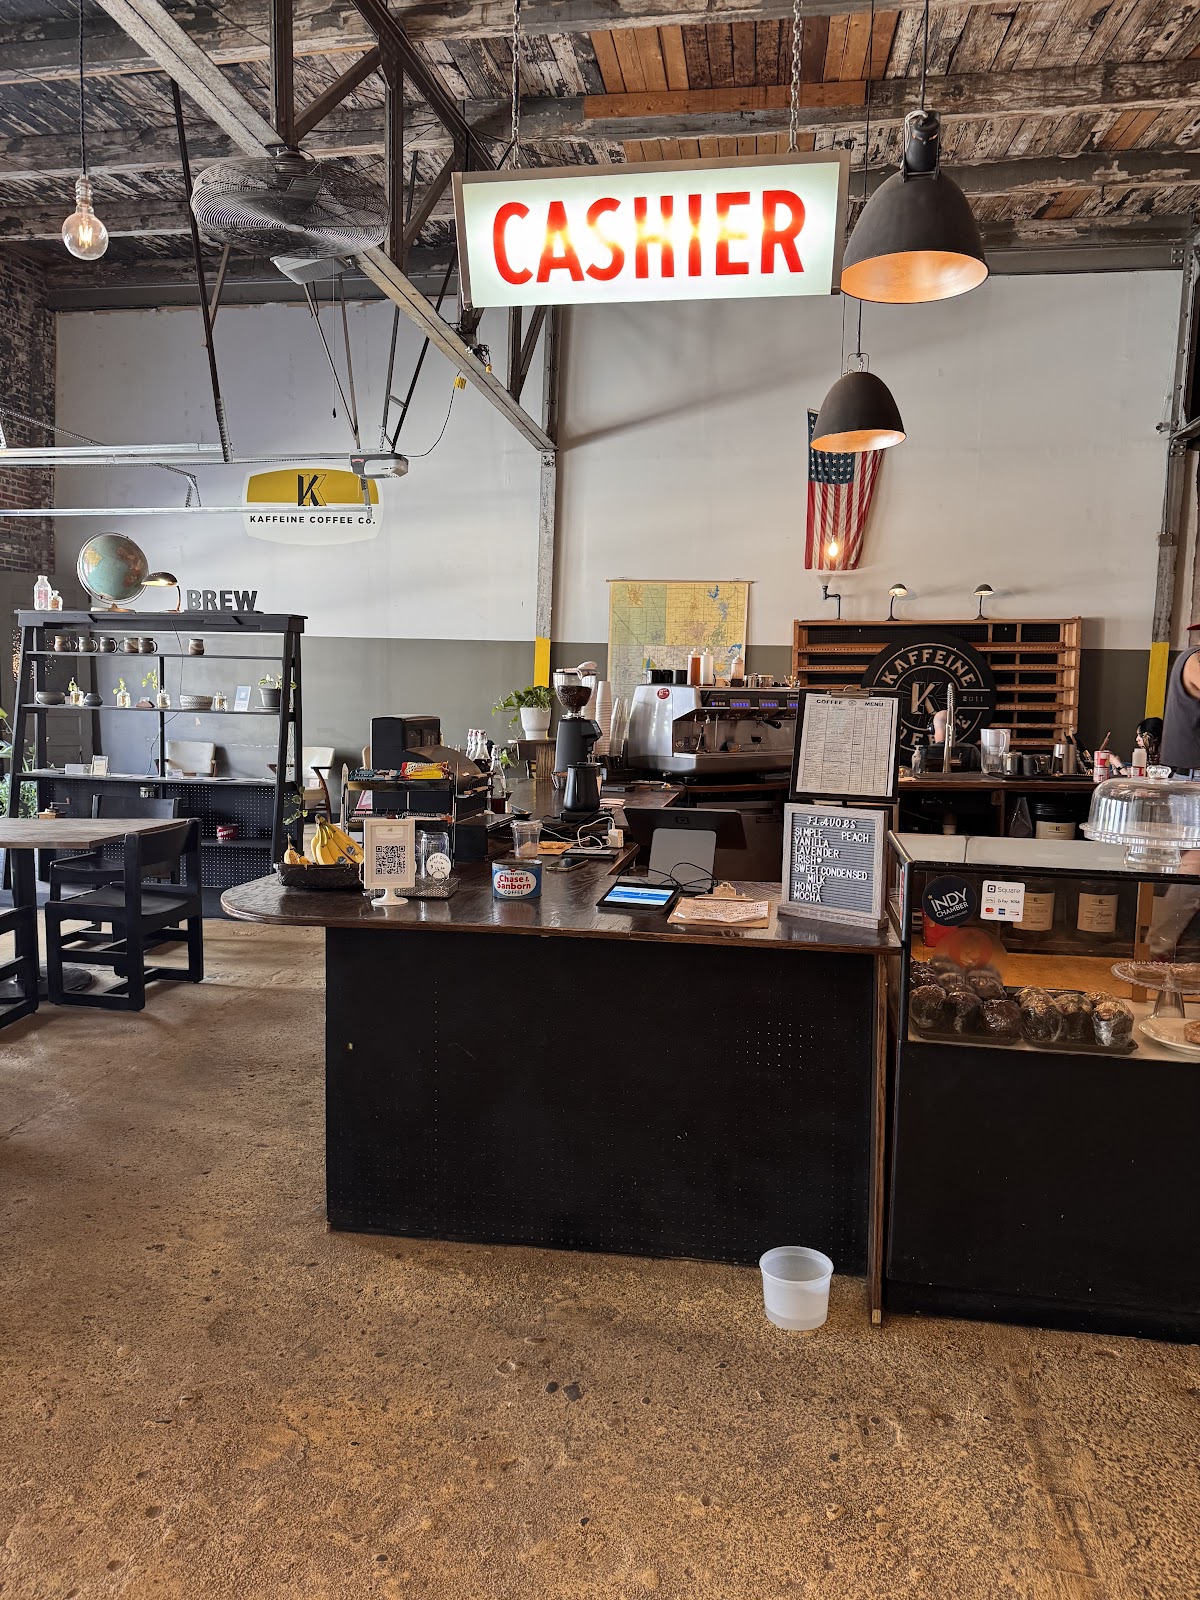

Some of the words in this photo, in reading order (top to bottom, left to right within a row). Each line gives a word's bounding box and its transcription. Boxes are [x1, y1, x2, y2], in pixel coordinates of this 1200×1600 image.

[492, 189, 806, 285] CASHIER
[297, 473, 327, 506] K
[249, 515, 305, 523] KAFFEINE
[309, 516, 353, 524] COFFEE
[186, 589, 258, 611] BREW
[880, 648, 977, 687] KAFFEINE
[910, 681, 943, 715] K
[806, 816, 857, 829] FLAVORS
[794, 827, 823, 838] SIMPLE
[841, 831, 869, 843] PEACH
[794, 836, 829, 848] VANILLA
[795, 846, 839, 858] LAVENDER
[795, 854, 816, 865] IRISH
[794, 863, 819, 875] SWEET
[821, 866, 868, 881] CONDENSED
[807, 873, 825, 885] MILK
[497, 881, 531, 890] Sanborn
[794, 881, 822, 893] HONEY
[793, 890, 821, 902] MOCHA
[936, 901, 969, 918] CHAMBER
[955, 973, 997, 988] BIRDS
